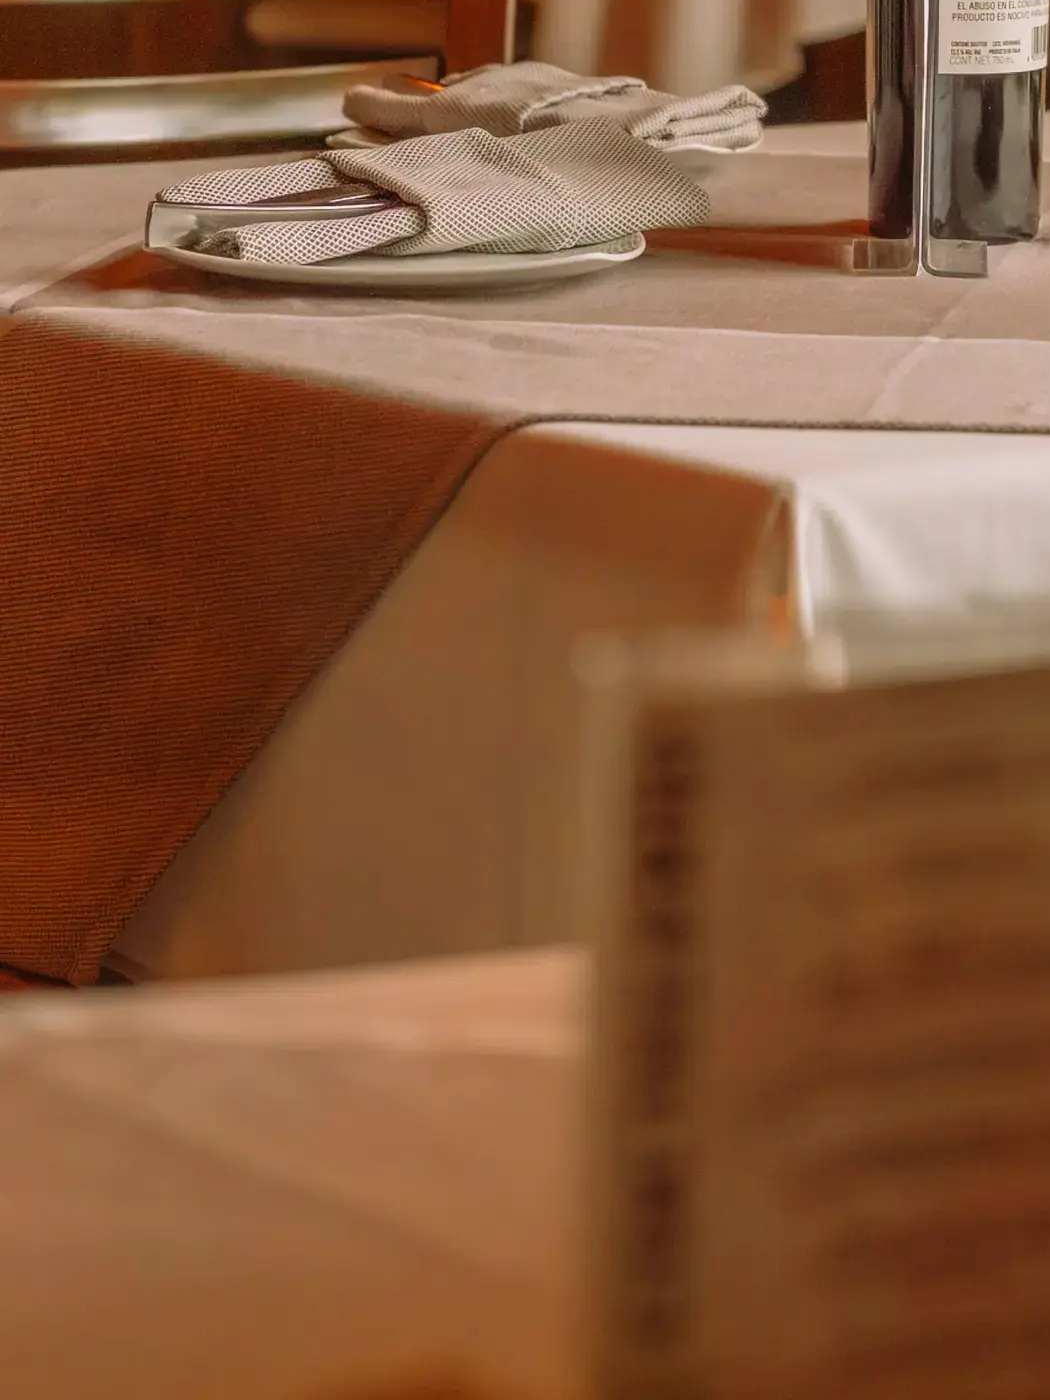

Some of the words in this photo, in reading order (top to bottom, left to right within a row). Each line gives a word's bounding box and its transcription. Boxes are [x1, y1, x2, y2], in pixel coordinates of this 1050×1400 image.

[957, 2, 966, 11] EL
[969, 2, 996, 11] ABUSO
[997, 1, 1007, 10] EN
[1008, 1, 1017, 9] EL
[952, 13, 996, 22] PRODUCTO
[997, 12, 1006, 21] ES
